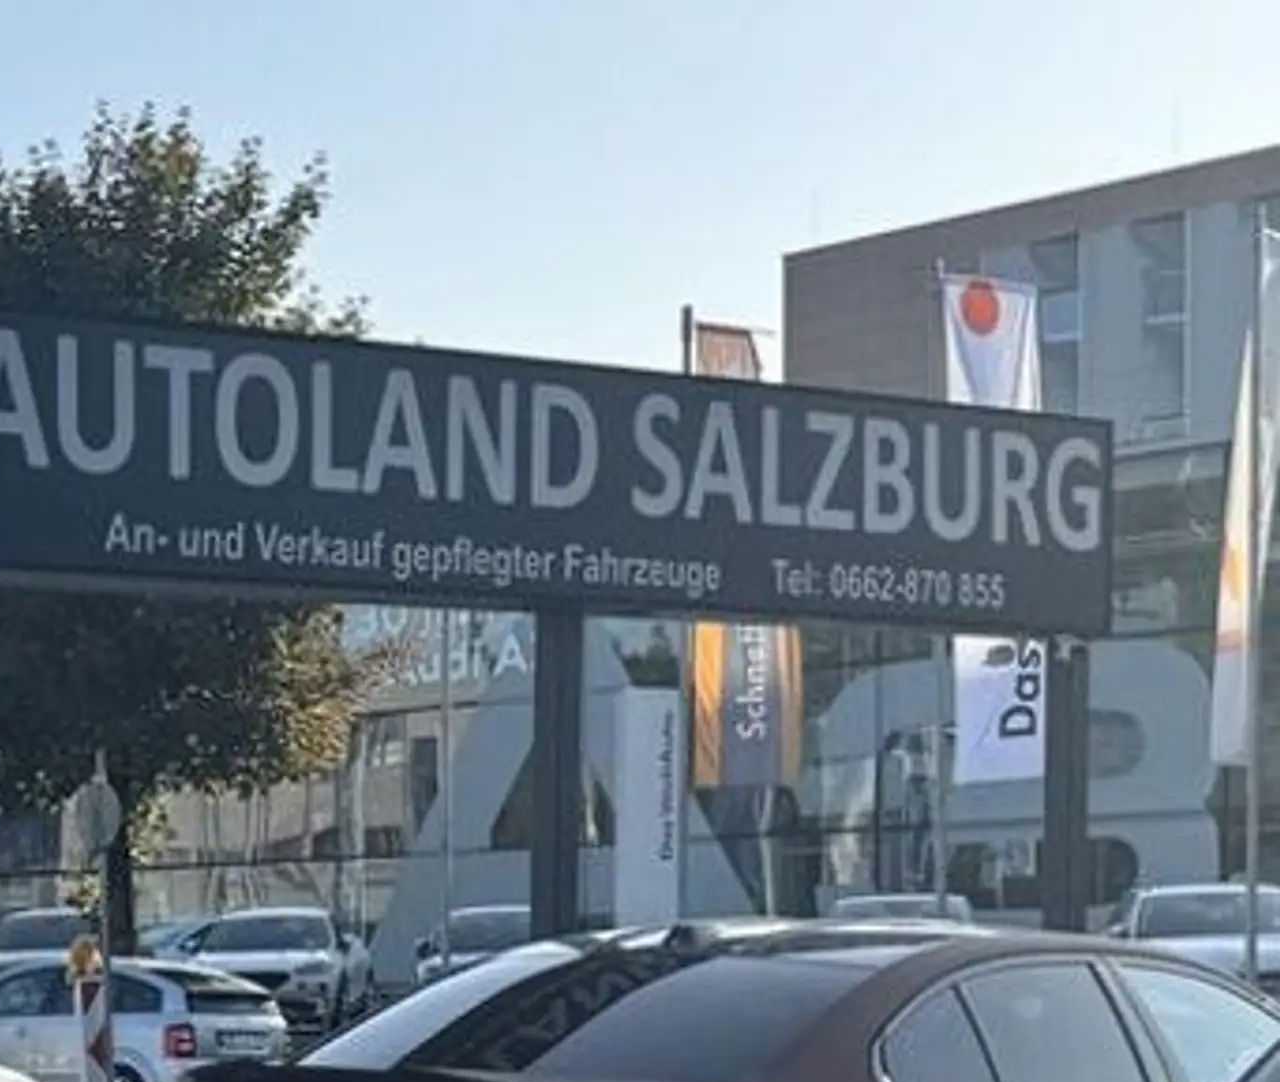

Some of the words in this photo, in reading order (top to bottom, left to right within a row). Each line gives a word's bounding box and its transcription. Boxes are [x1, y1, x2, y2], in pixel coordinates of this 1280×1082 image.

[631, 393, 1104, 551] SALZBURG
[105, 511, 169, 555] An-
[178, 521, 244, 560] und
[254, 522, 385, 569] Verkauf
[392, 535, 555, 588] gepflegter
[563, 543, 720, 598] Fahrzeuge
[771, 558, 822, 597] Tel:
[958, 573, 1006, 608] 855
[998, 636, 1042, 738] Das
